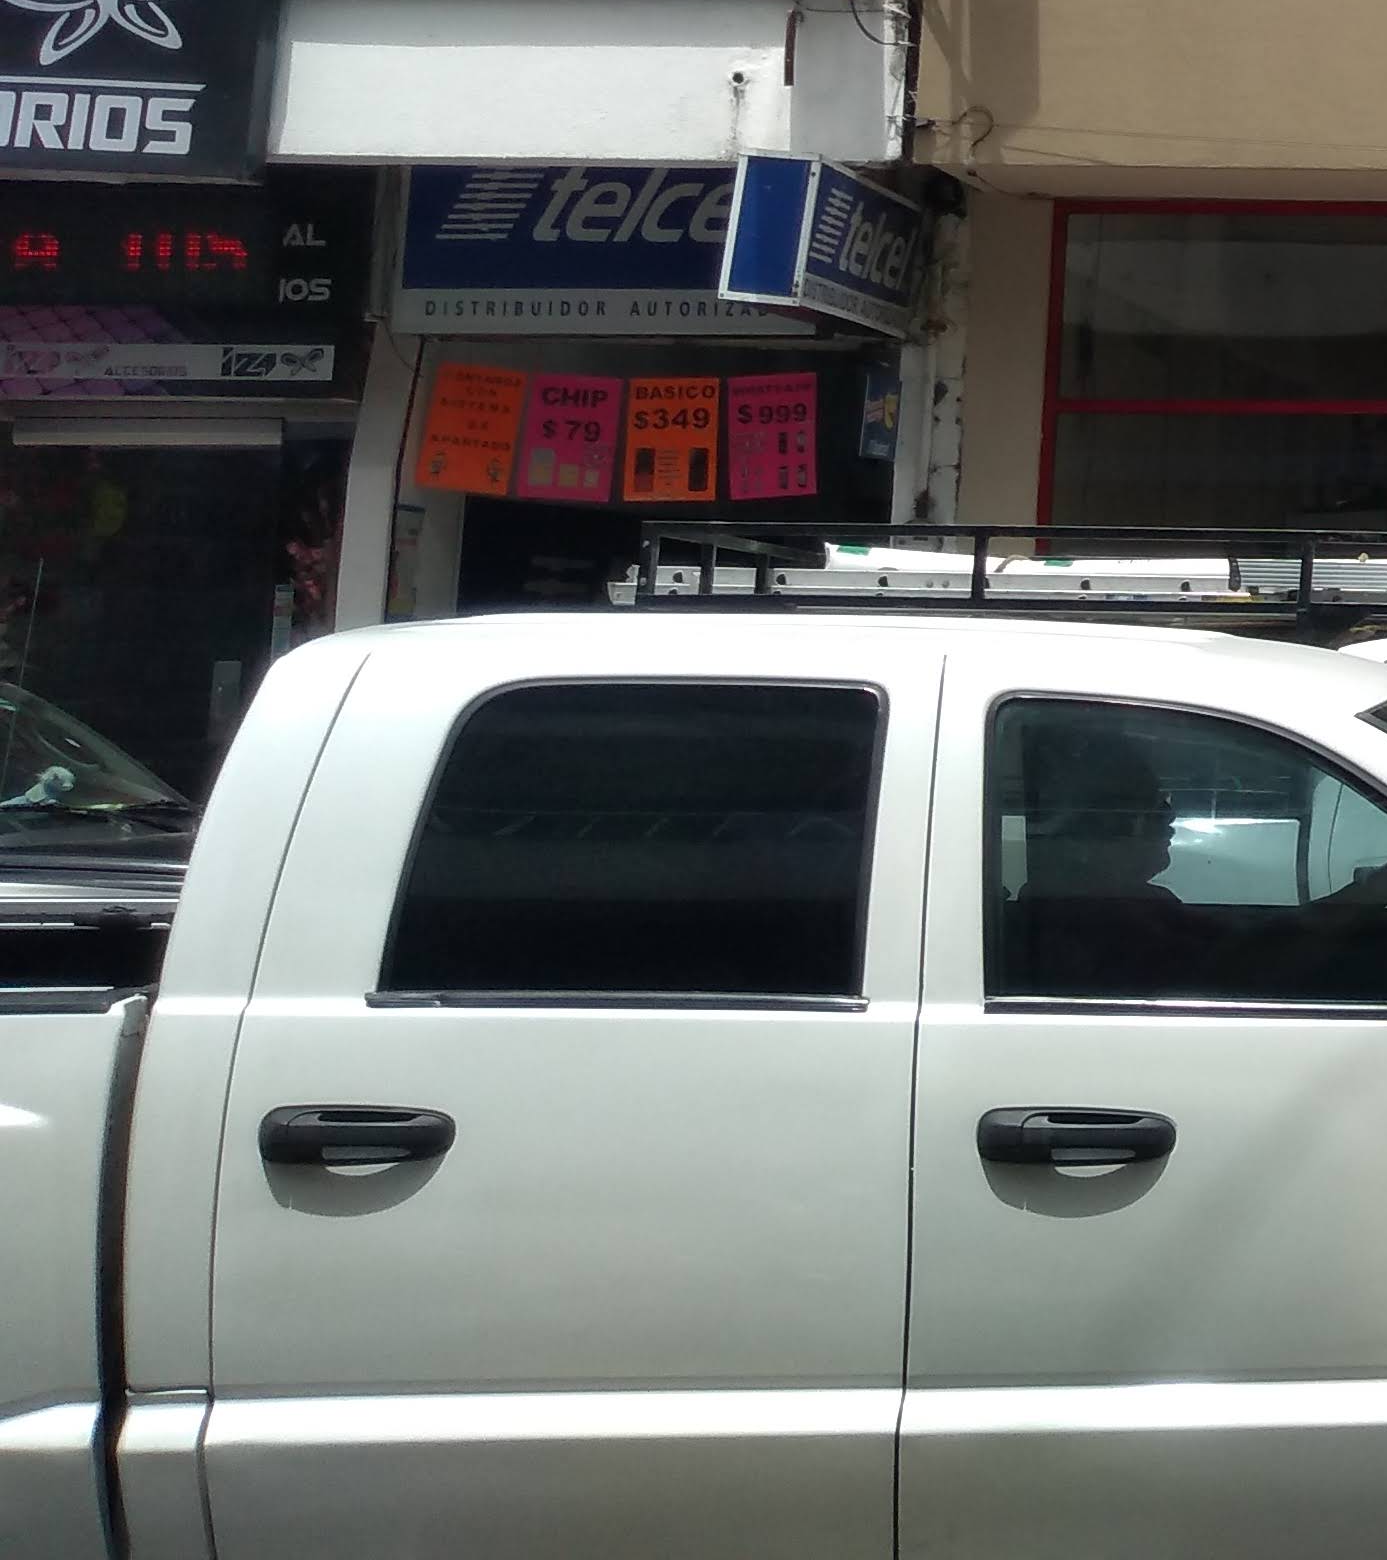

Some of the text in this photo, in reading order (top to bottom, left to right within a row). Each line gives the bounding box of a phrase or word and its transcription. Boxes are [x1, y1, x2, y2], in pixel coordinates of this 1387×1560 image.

[0, 90, 196, 155] RIOS
[282, 223, 327, 247] AL
[839, 201, 918, 292] telcel
[425, 299, 607, 317] DISTRIBUIDOR
[542, 386, 609, 408] CHIP
[635, 384, 716, 401] BASICO
[633, 407, 711, 430] $349
